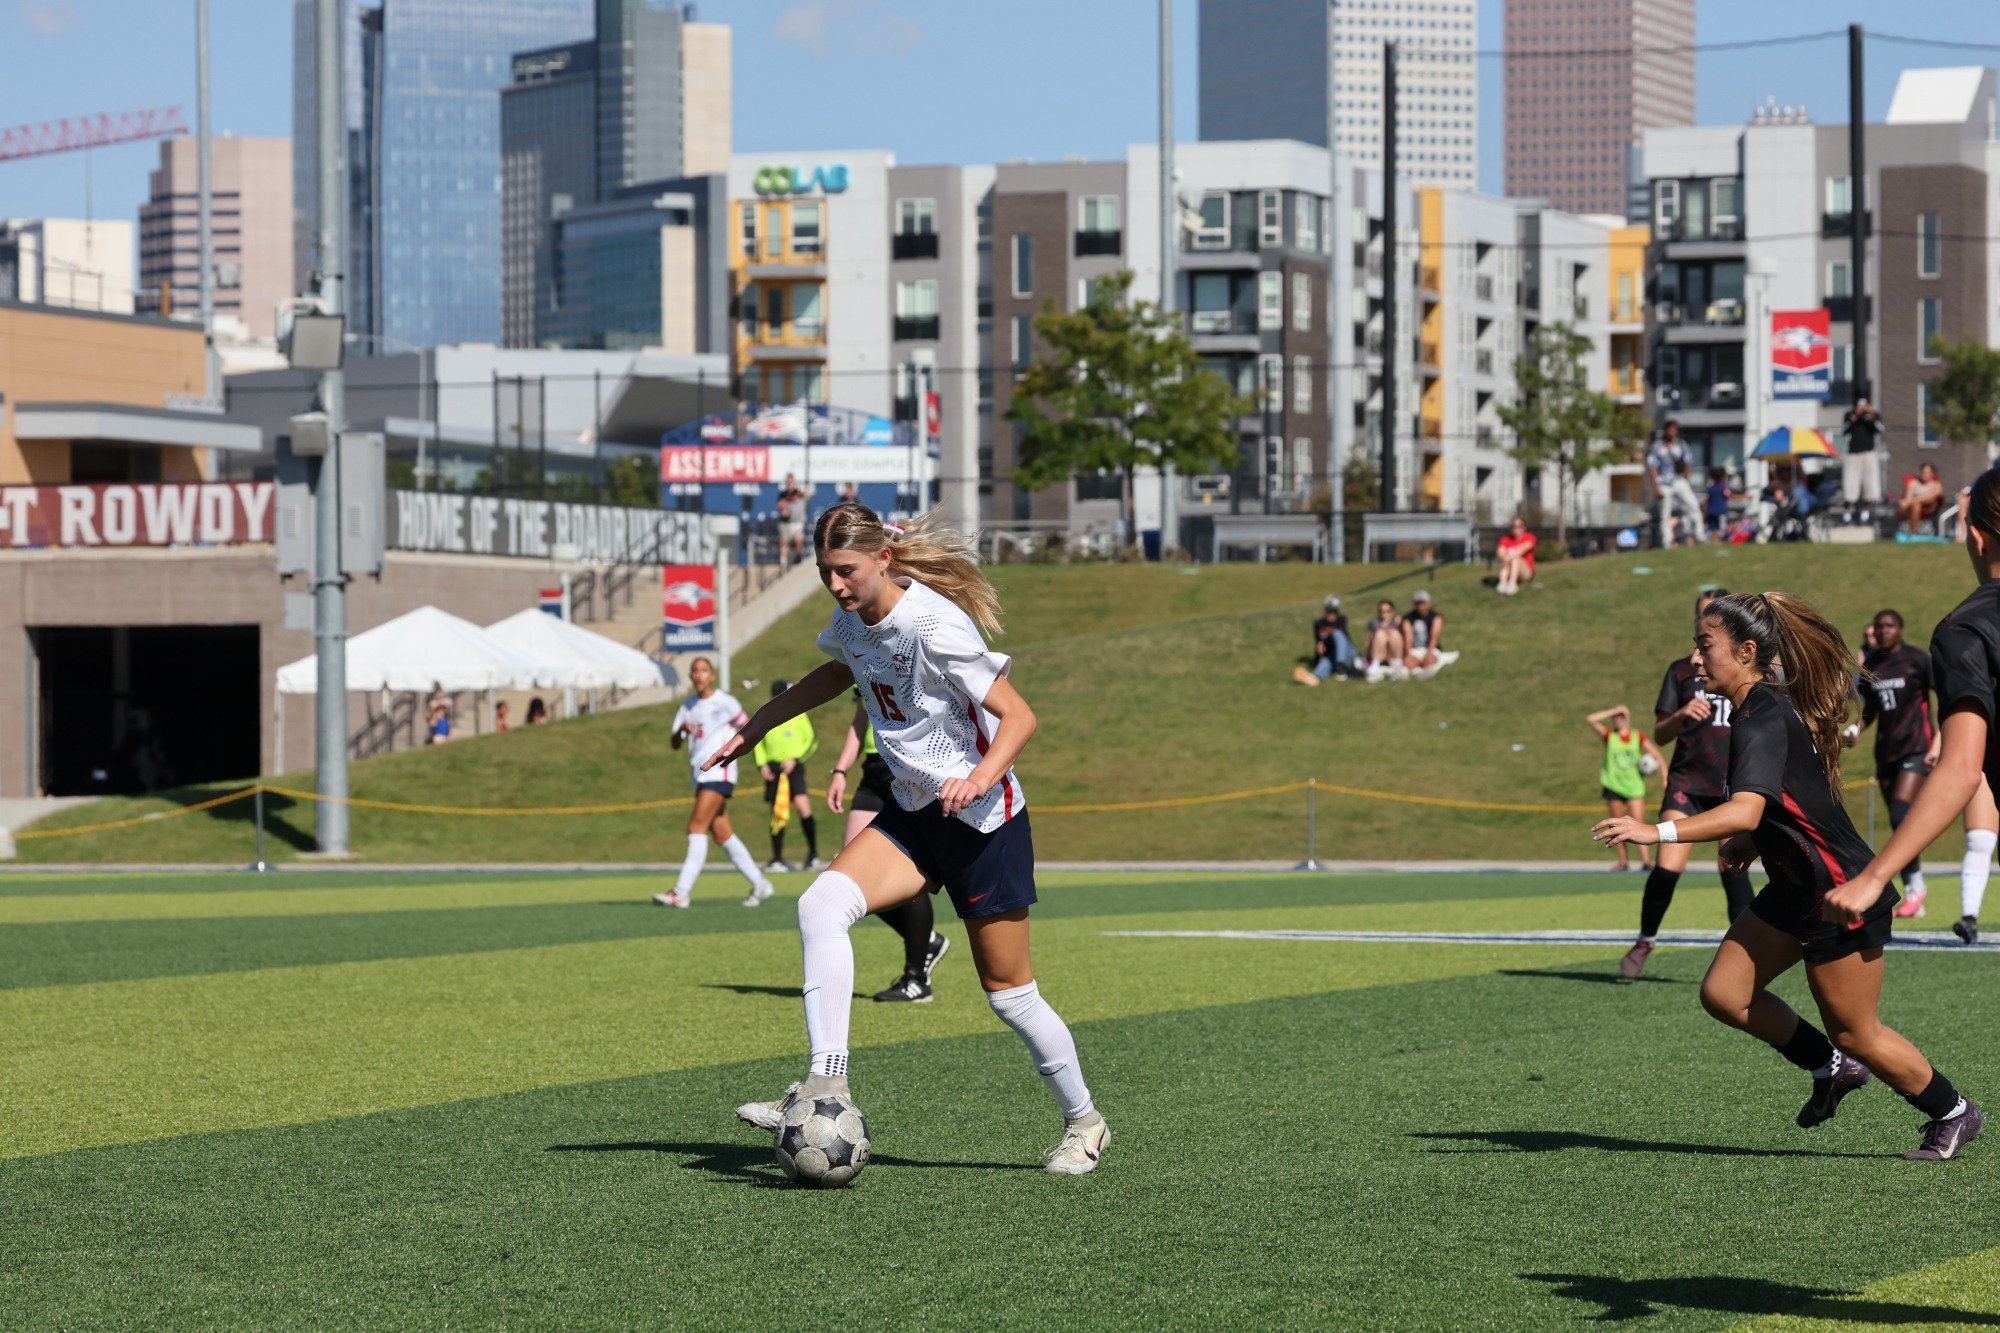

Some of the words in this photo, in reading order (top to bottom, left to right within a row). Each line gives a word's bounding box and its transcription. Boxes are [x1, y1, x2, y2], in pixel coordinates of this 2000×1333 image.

[668, 451, 767, 479] ASSEMLY
[57, 482, 275, 545] ROWDY
[396, 489, 467, 552] HOME
[470, 495, 499, 554] OF
[503, 498, 552, 558] THE
[870, 681, 907, 722] 15
